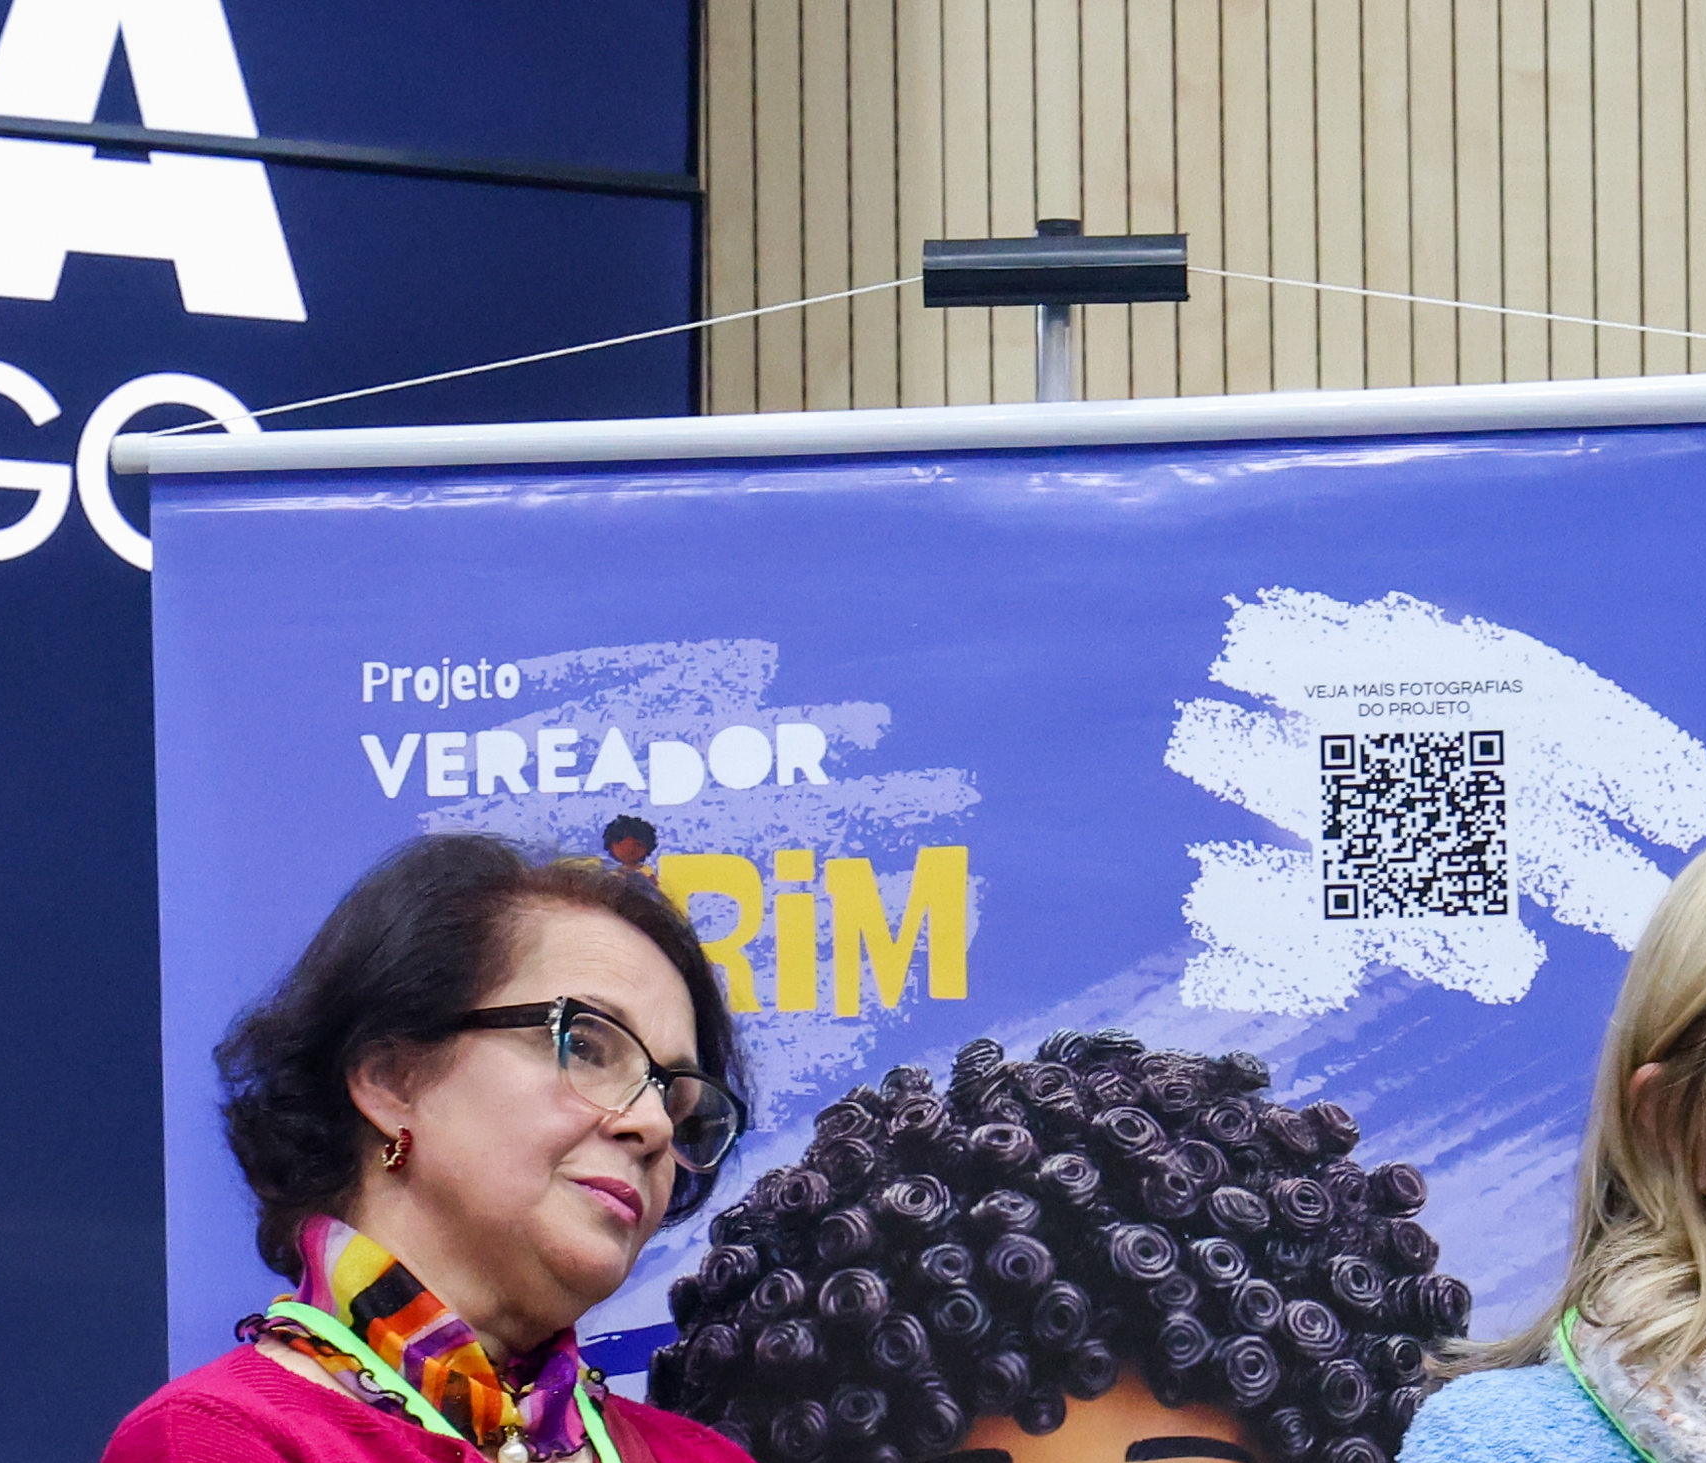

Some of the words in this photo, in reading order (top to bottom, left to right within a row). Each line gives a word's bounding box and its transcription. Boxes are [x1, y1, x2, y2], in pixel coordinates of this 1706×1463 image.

[361, 656, 520, 709] Projeto
[1304, 684, 1349, 699] VEJA
[1353, 682, 1396, 697] MAIS
[1399, 679, 1524, 696] FOTOGRAFIAS
[1358, 703, 1385, 717] DO
[1389, 700, 1471, 716] PROJETO
[361, 722, 829, 806] VEREADOR
